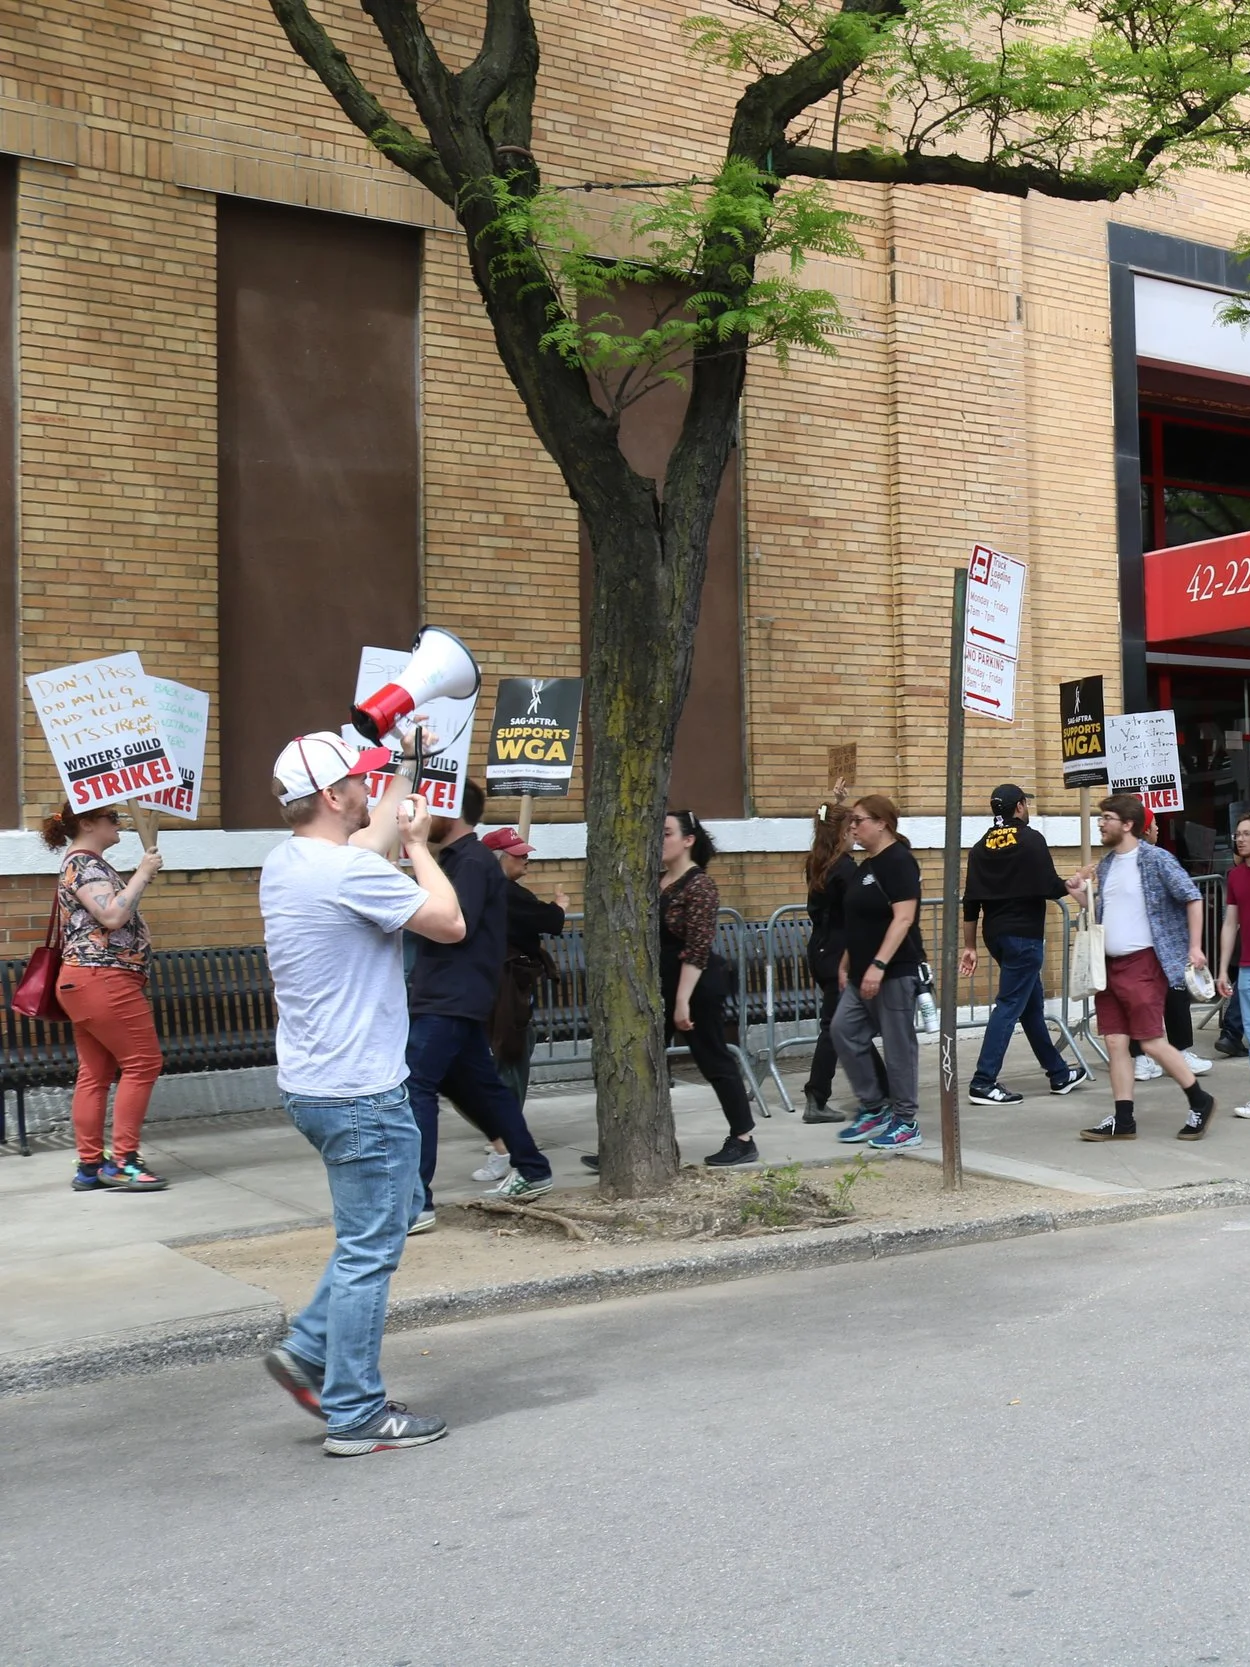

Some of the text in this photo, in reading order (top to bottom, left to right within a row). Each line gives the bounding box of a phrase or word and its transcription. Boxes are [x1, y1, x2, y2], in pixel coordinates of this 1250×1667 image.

[993, 557, 1007, 570] Truck
[991, 568, 1011, 584] Loading
[990, 578, 1001, 592] Only
[970, 591, 989, 609] Monday
[994, 600, 1009, 615] Friday
[967, 649, 1005, 671] NO PARKING
[967, 665, 985, 679] Monday
[989, 672, 1003, 686] Friday
[497, 728, 570, 739] SUPPORTS
[1063, 723, 1101, 737] SUPPORTS
[496, 739, 566, 761] WGA
[1064, 735, 1102, 756] WGA
[63, 737, 161, 772] WRITERS GUILD
[111, 760, 125, 770] ON
[426, 756, 458, 771] UILD
[73, 757, 174, 805] STRIKE!
[178, 766, 195, 780] ILD
[1111, 777, 1148, 787] WRITERS
[1150, 774, 1175, 783] GUILD
[136, 786, 193, 812] IKE!
[986, 833, 1017, 849] WGA
